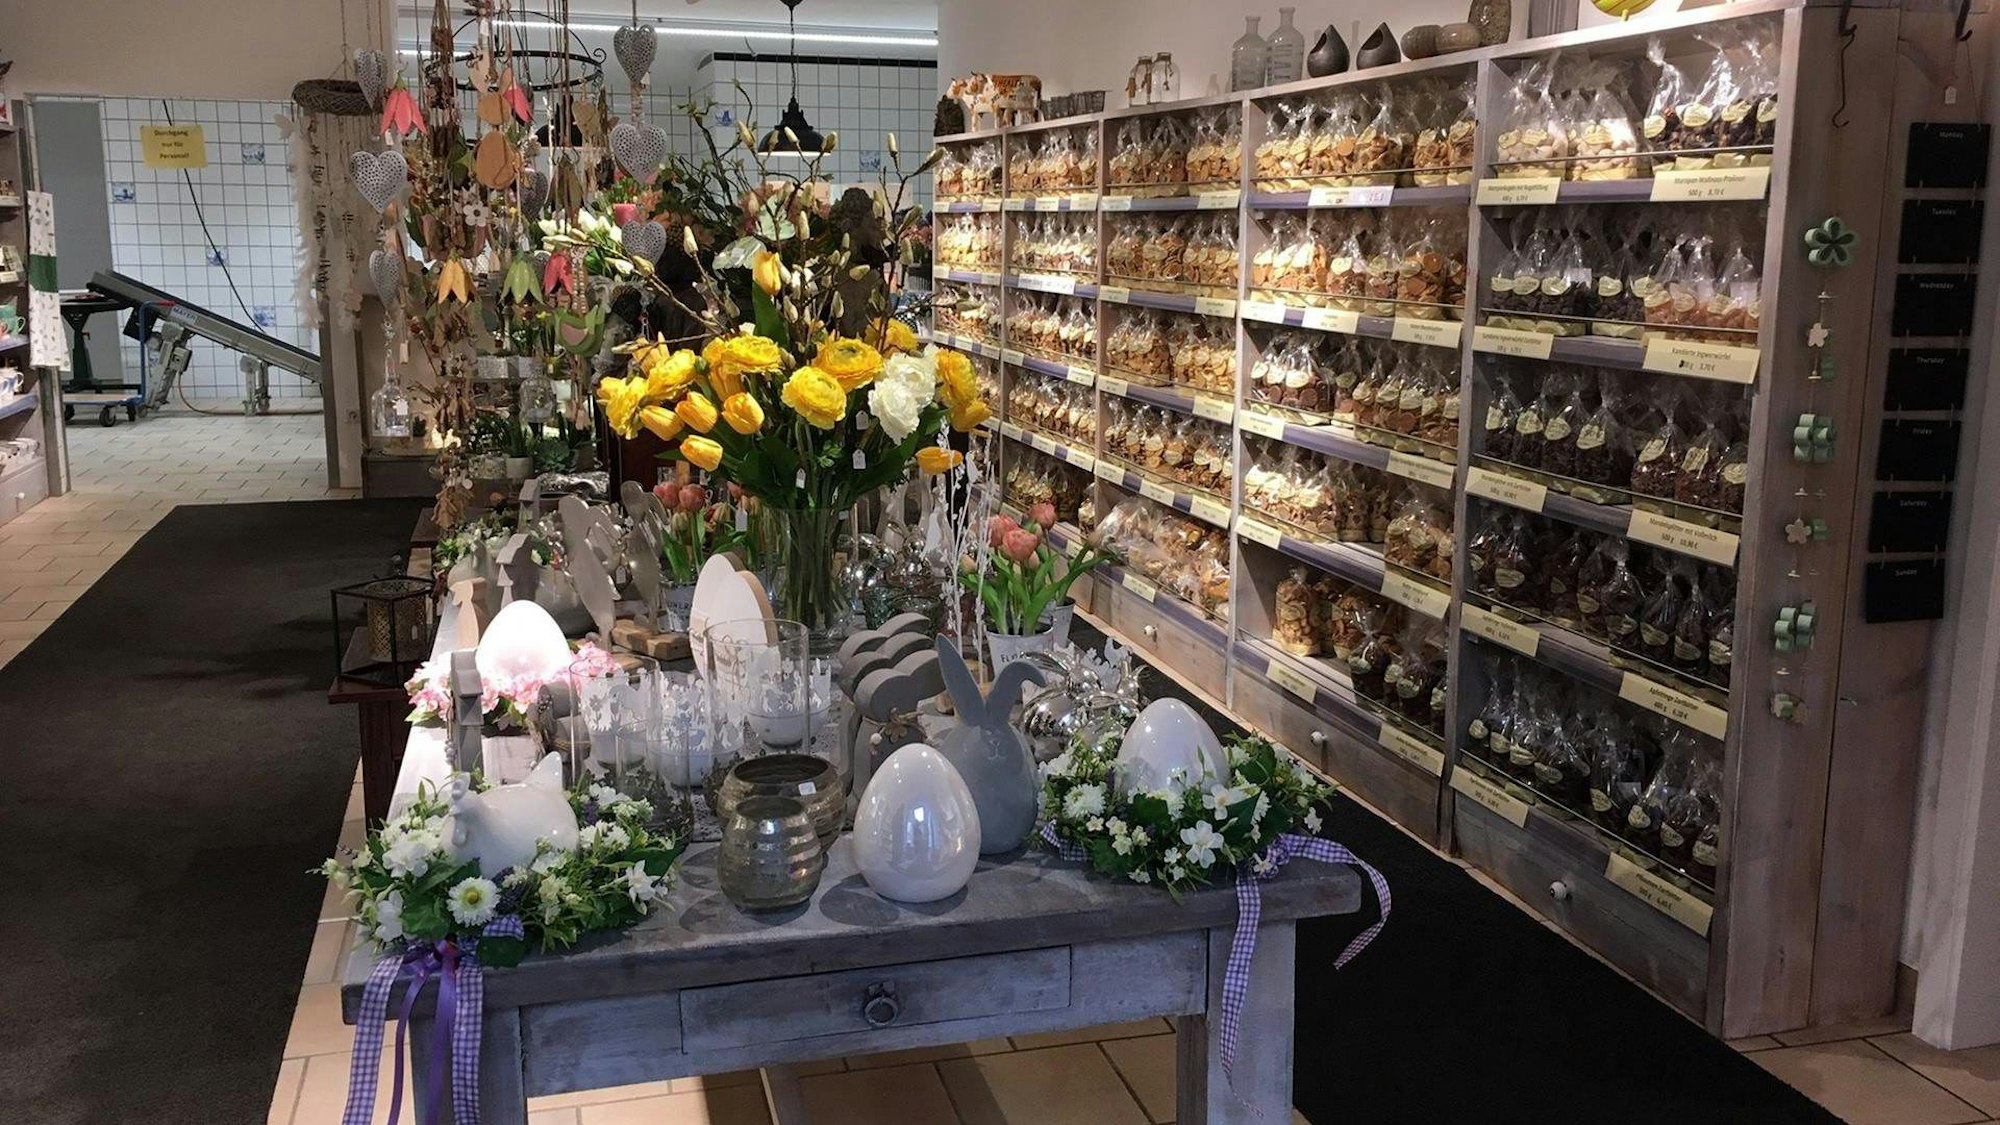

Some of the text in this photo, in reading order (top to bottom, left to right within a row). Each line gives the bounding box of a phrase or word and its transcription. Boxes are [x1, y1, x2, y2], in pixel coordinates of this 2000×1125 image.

[1919, 282, 1955, 290] Wednesday
[1916, 356, 1945, 365] Thursday
[1899, 500, 1927, 508] Saturday
[1895, 568, 1918, 577] Sunday
